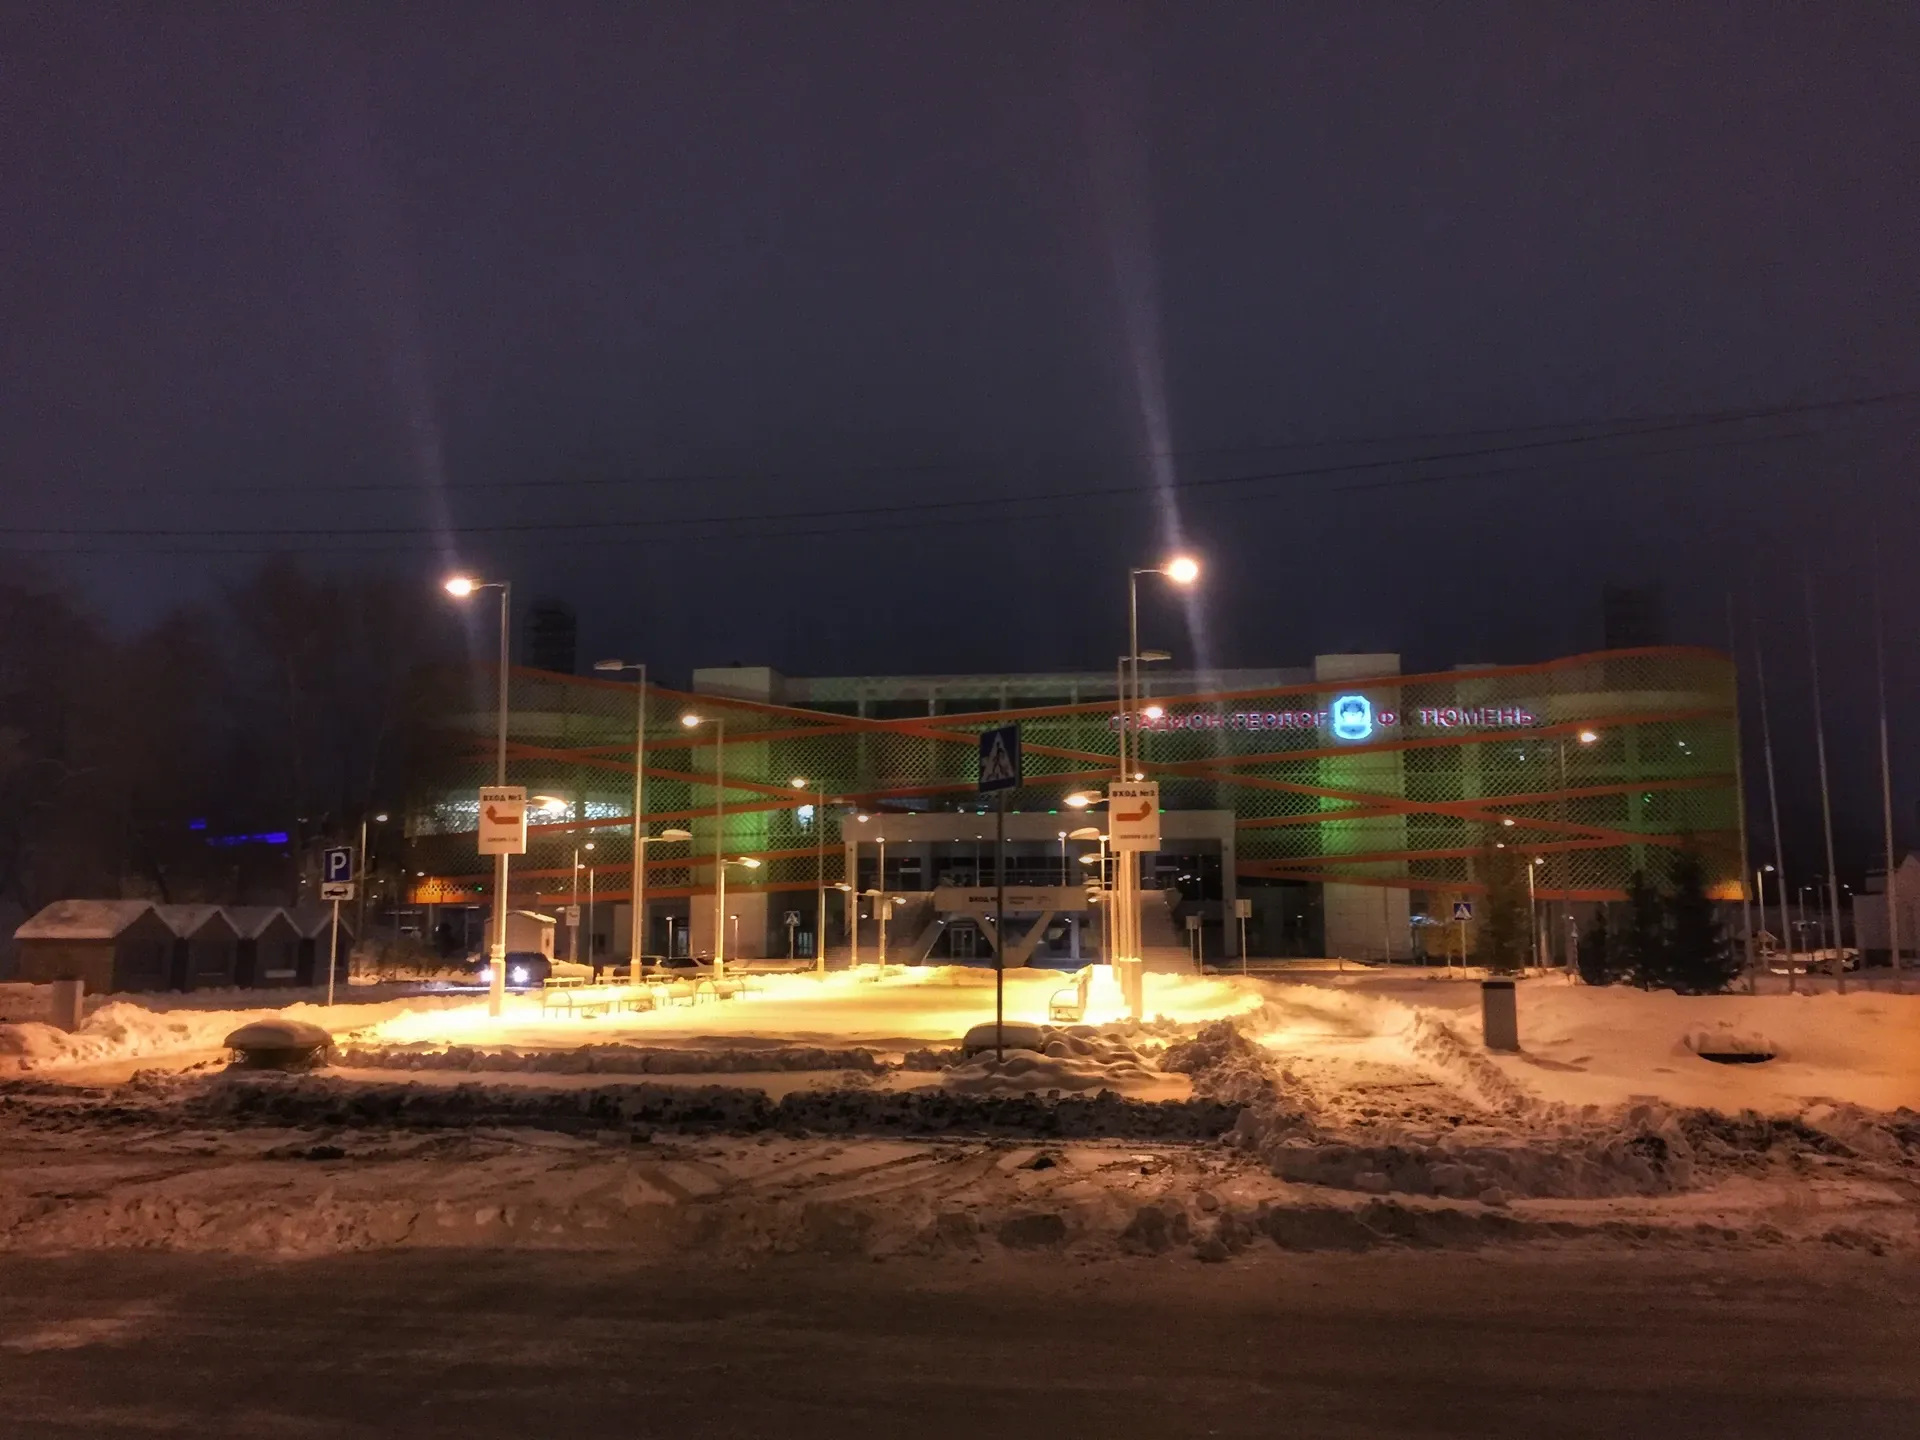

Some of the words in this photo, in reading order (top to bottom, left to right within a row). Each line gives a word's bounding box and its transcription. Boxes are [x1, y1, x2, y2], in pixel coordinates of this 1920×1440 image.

[1232, 710, 1329, 729] ГЕОЛОГ
[1419, 707, 1535, 727] ТЮМЕНЬ
[483, 794, 506, 802] ВХОД
[330, 852, 347, 879] P
